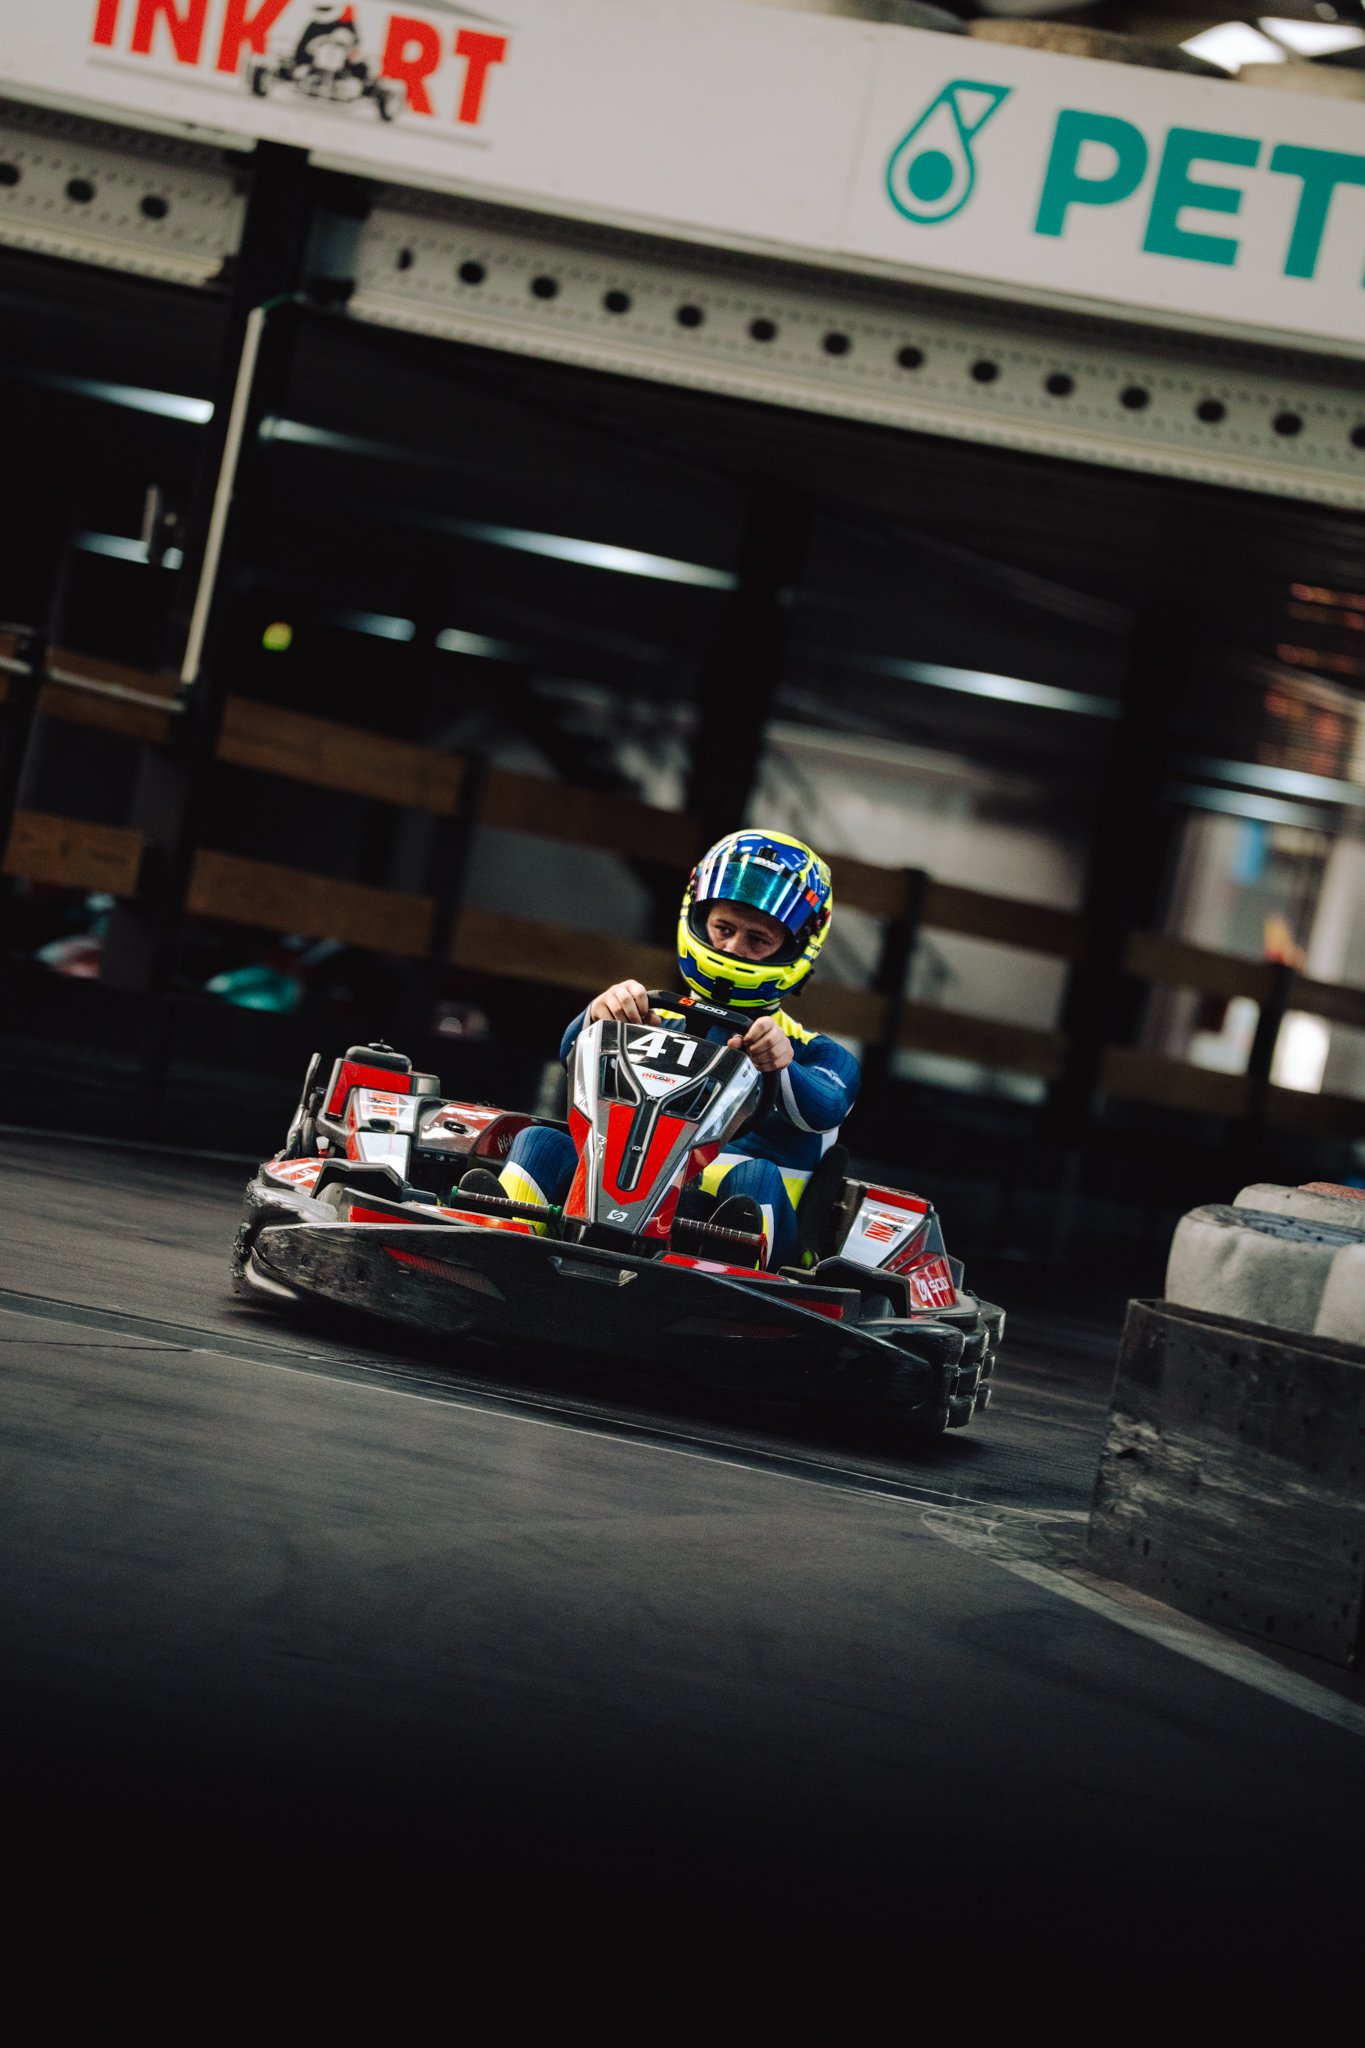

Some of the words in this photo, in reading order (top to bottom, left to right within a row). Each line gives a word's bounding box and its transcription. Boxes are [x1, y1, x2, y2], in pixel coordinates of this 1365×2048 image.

[91, 0, 508, 126] INKRT
[1034, 108, 1365, 289] PET
[694, 1002, 728, 1016] SODI
[627, 1031, 698, 1067] 41
[641, 1072, 677, 1085] INKRT
